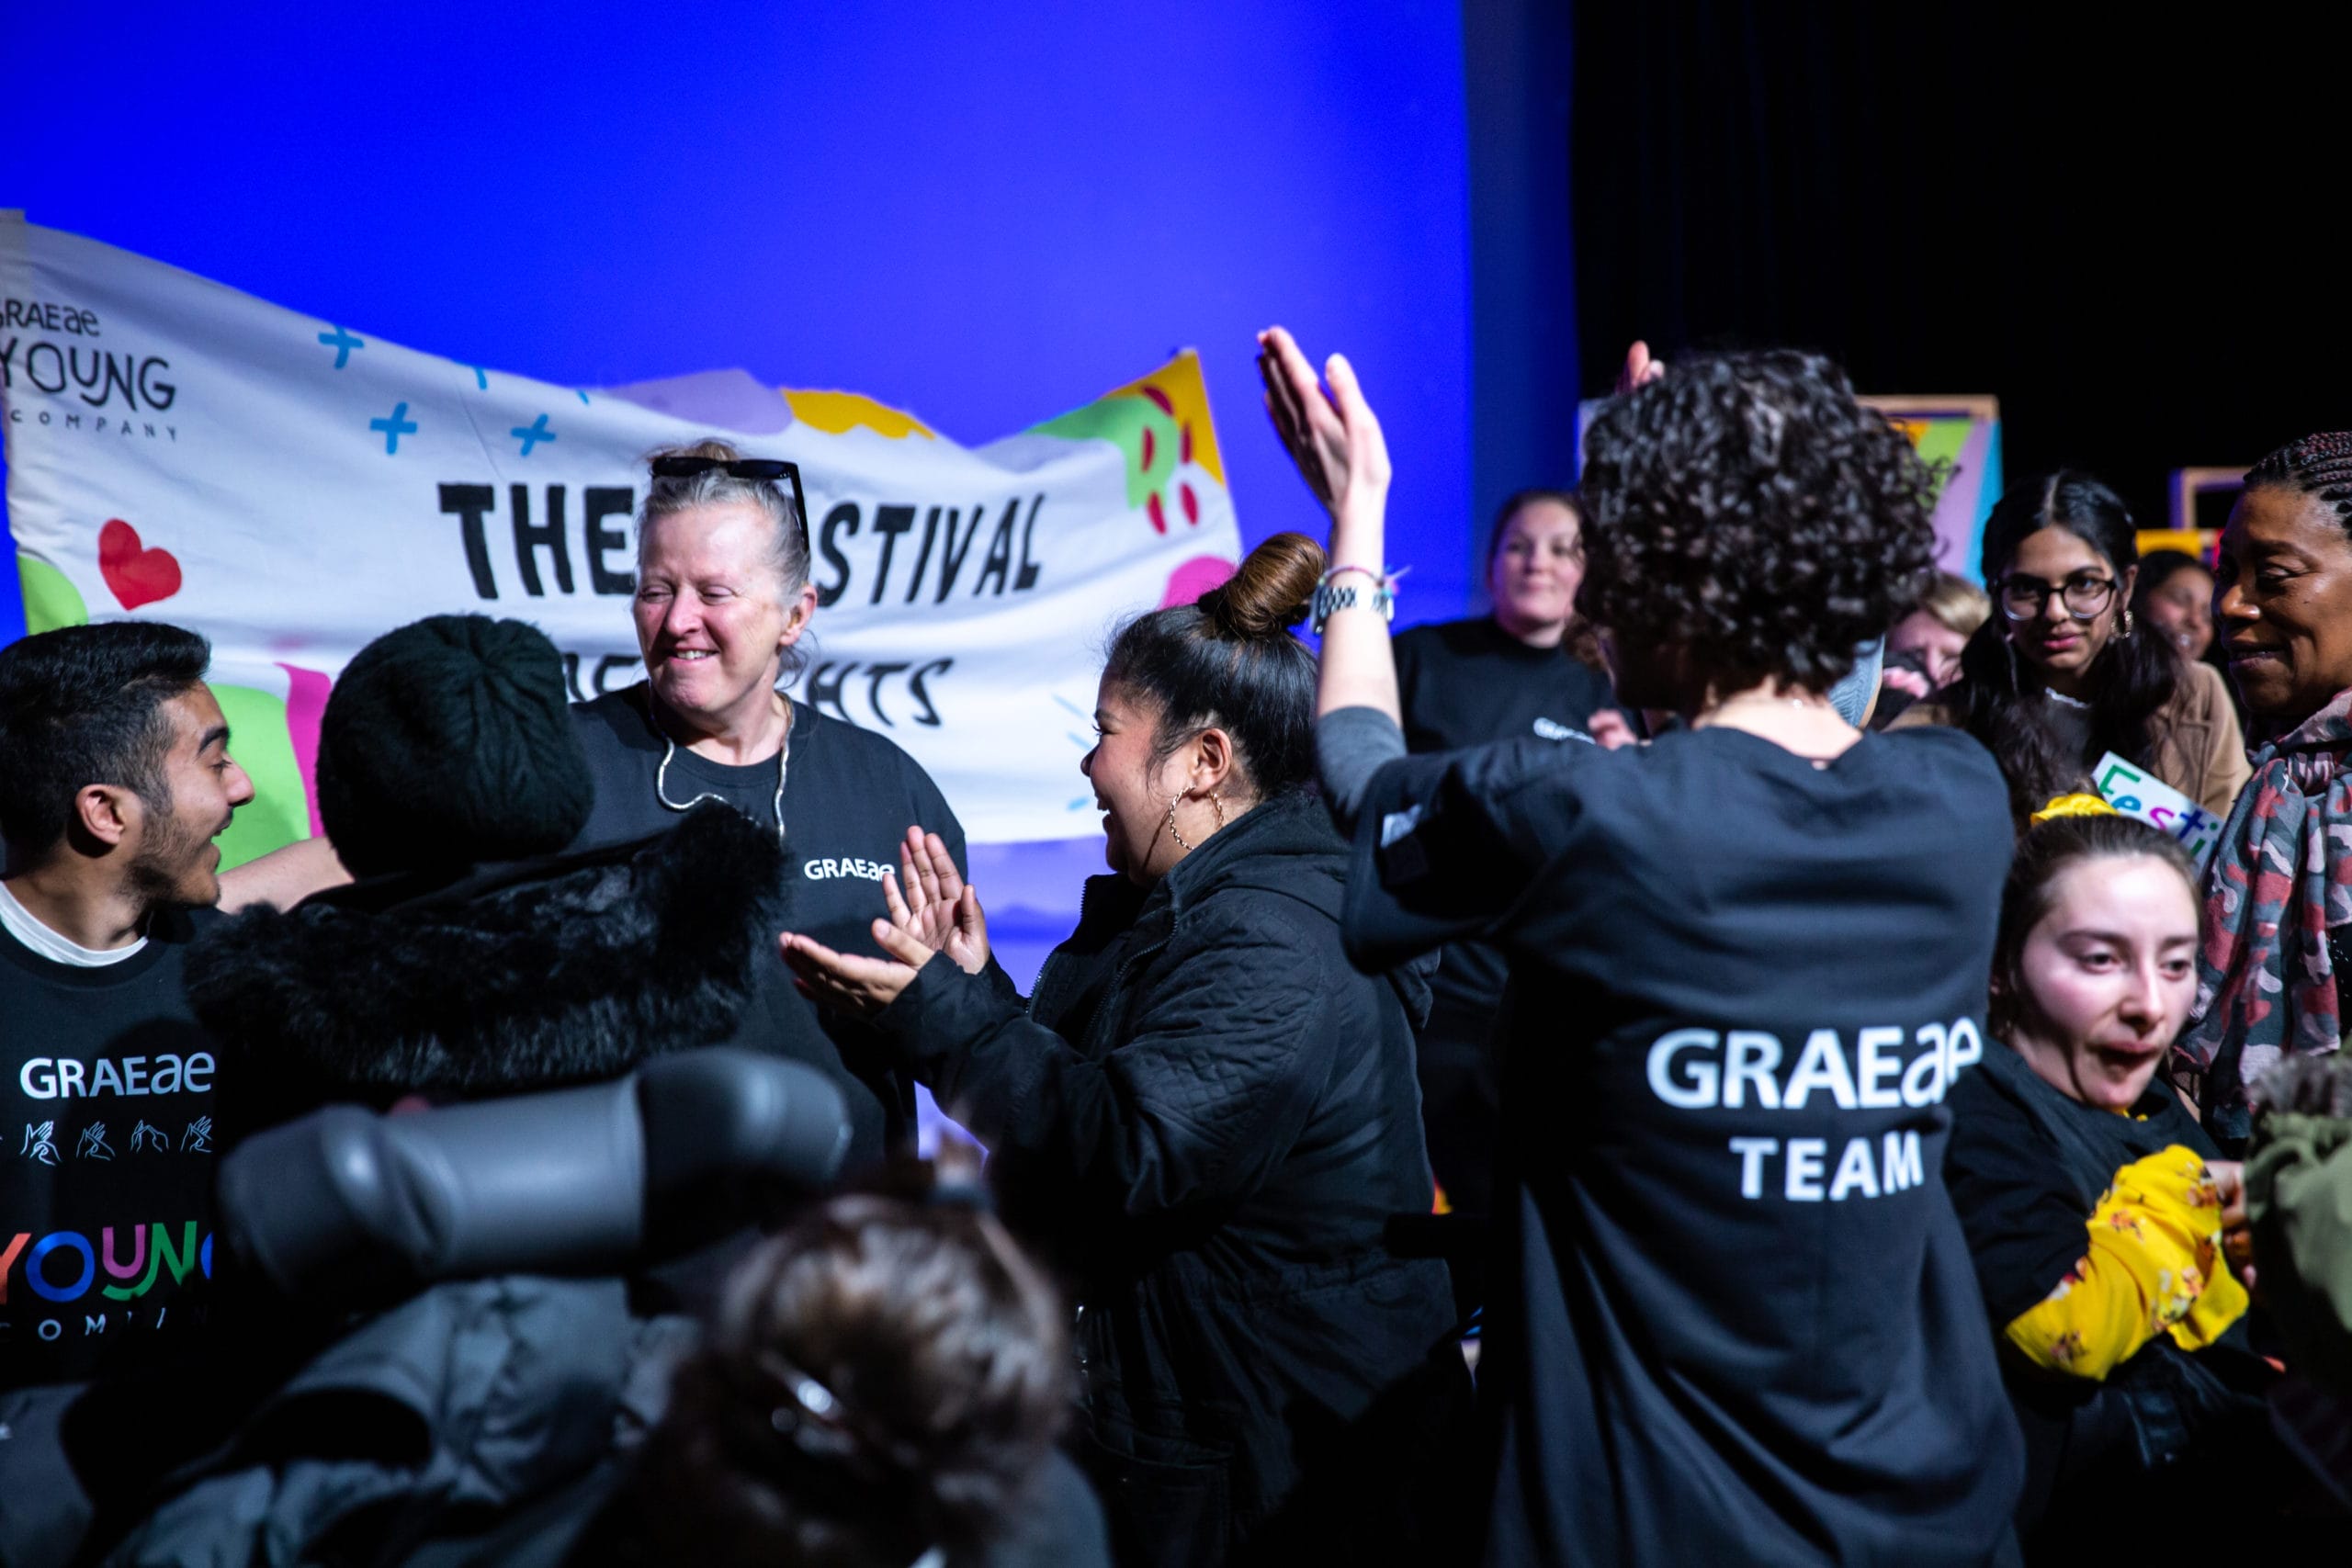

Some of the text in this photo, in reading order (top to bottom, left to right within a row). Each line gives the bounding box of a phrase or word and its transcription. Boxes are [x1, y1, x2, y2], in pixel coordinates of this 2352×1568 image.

[0, 298, 100, 336] RAEae
[0, 337, 176, 412] YOUNG
[10, 409, 177, 441] COMPANY
[437, 482, 1045, 607] THE STIVAL
[19, 1052, 216, 1100] GRAEae
[1729, 1130, 1924, 1201] TEAM
[0, 1220, 213, 1302] YOUN
